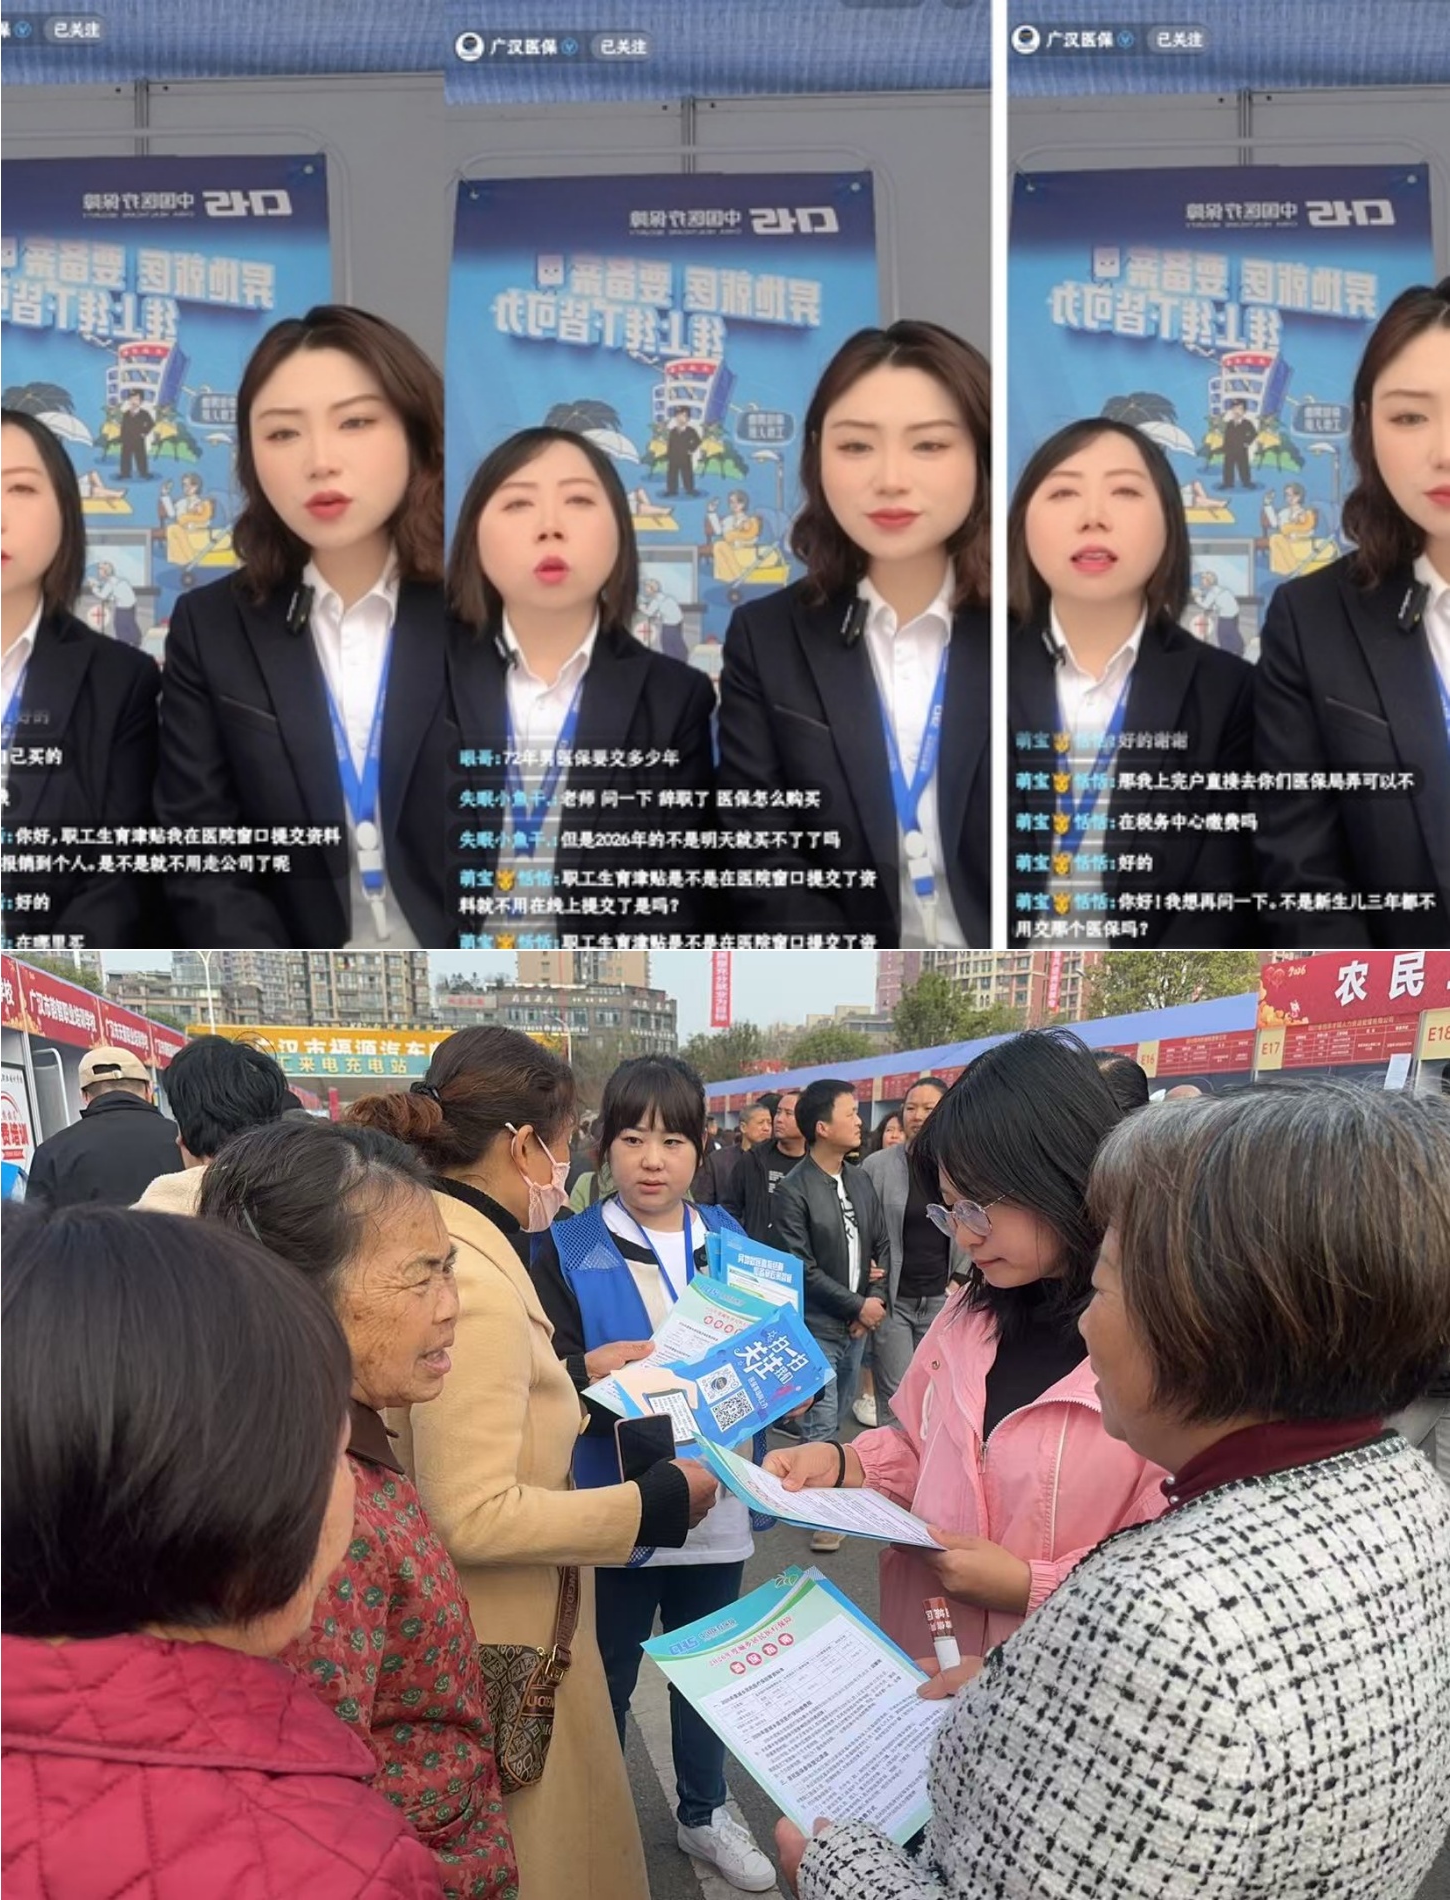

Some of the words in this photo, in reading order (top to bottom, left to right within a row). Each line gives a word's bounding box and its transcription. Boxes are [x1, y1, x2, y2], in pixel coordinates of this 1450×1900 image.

[1334, 951, 1450, 1007] 农民
[1428, 1027, 1450, 1041] E18
[256, 1037, 441, 1057] 广汉市福源汽车
[1262, 1042, 1281, 1055] E17
[1140, 1053, 1155, 1064] E16
